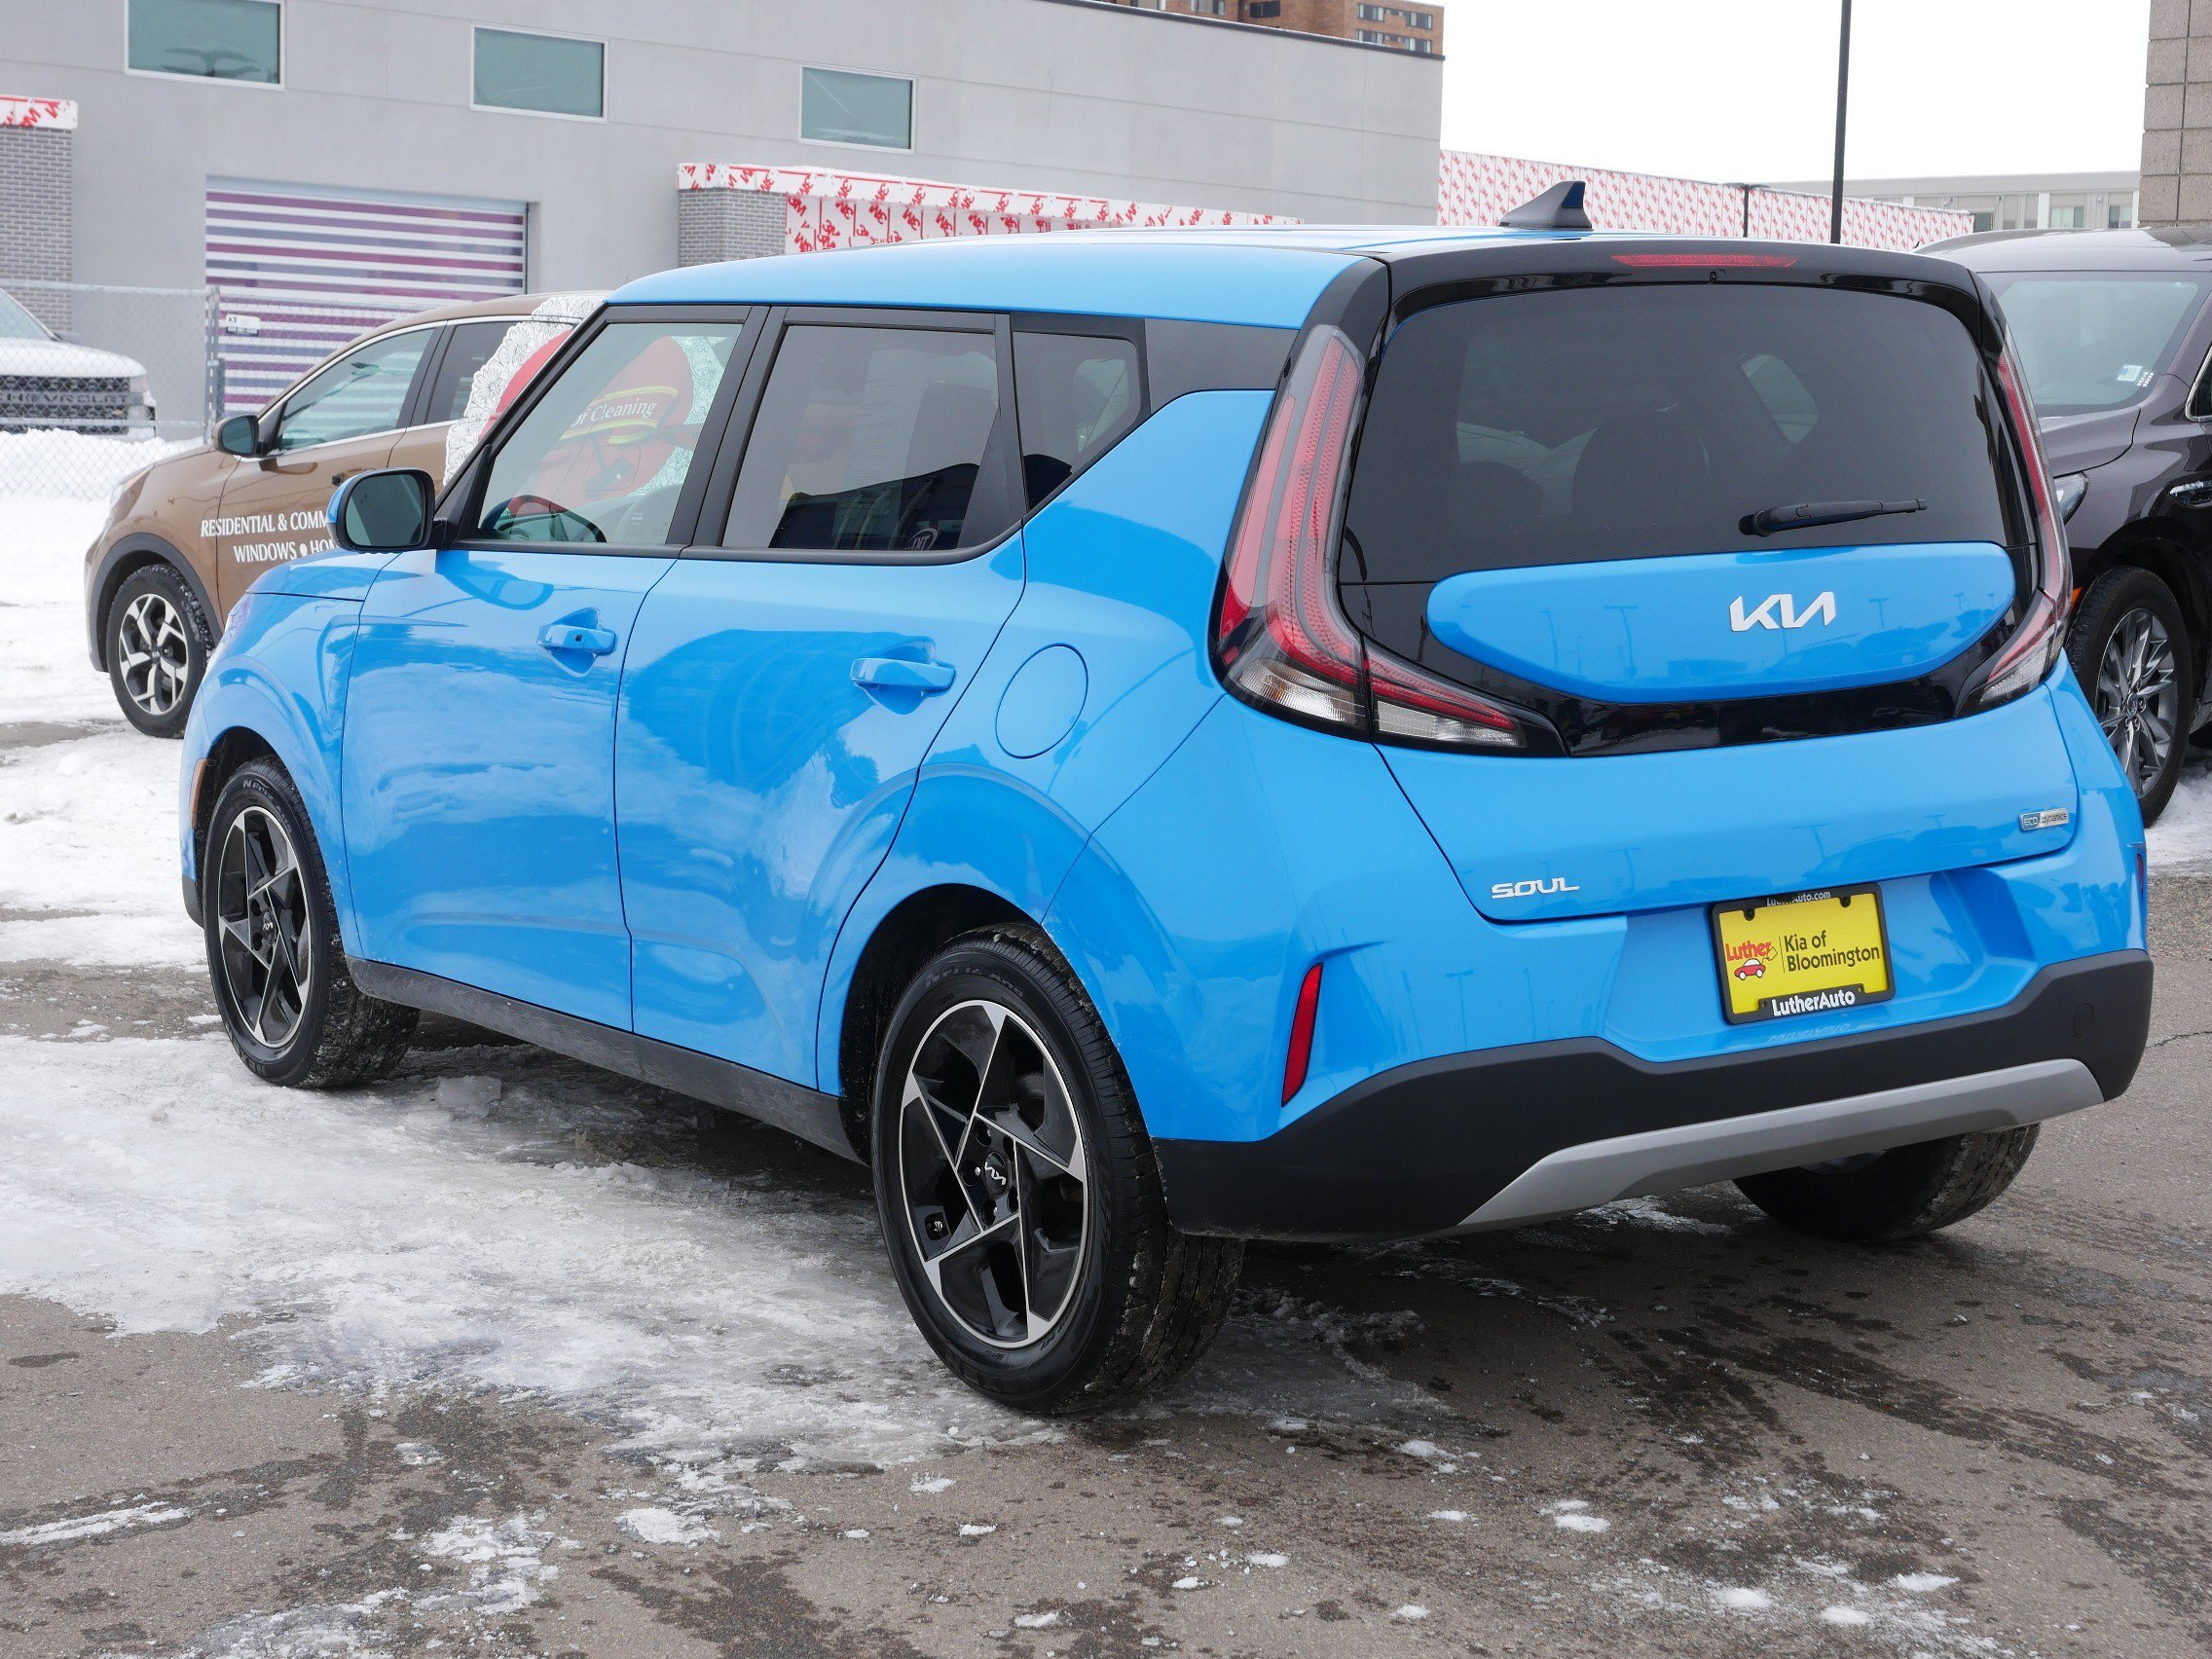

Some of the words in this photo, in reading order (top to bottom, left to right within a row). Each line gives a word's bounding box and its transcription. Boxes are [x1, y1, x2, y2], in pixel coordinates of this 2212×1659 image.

[0, 393, 128, 403] HEVROLET
[591, 398, 657, 422] Cleaning
[201, 514, 276, 537] RESIDENTIAL
[277, 513, 287, 532] &
[233, 541, 296, 563] WINDOWS
[1729, 591, 1837, 632] KIA
[2024, 816, 2039, 826] ECO
[1491, 877, 1580, 900] SOUL
[1766, 891, 1831, 907] LuAuto.com
[1724, 940, 1772, 962] Luther
[1784, 935, 1807, 952] Kia
[1811, 930, 1826, 948] of
[1787, 946, 1880, 973] Bloomington
[1771, 989, 1856, 1016] LutherAuto
